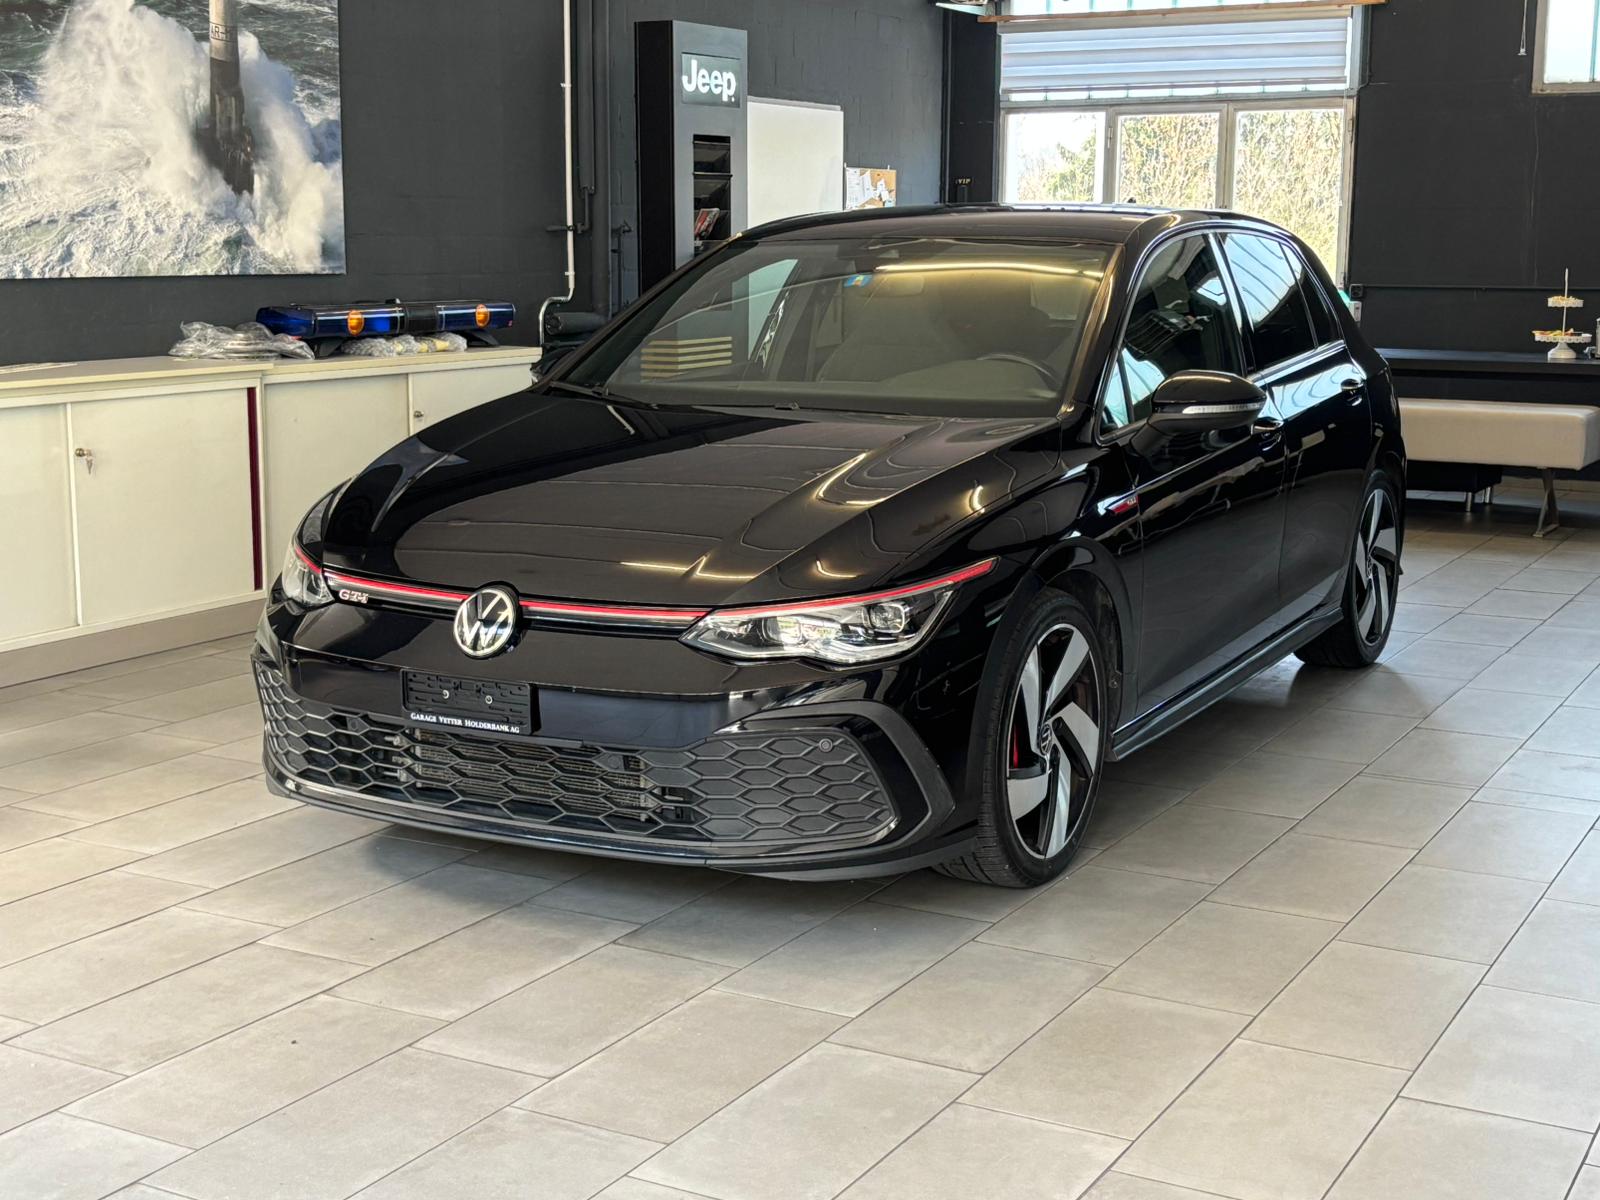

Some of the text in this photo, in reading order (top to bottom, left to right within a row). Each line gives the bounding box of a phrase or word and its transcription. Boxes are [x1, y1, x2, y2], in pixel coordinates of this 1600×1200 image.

[682, 59, 736, 102] Jeep
[339, 589, 369, 604] GTI
[454, 589, 514, 656] VW
[411, 712, 437, 723] GARAGE
[465, 719, 510, 733] HOLDERBANK
[510, 726, 520, 734] AG
